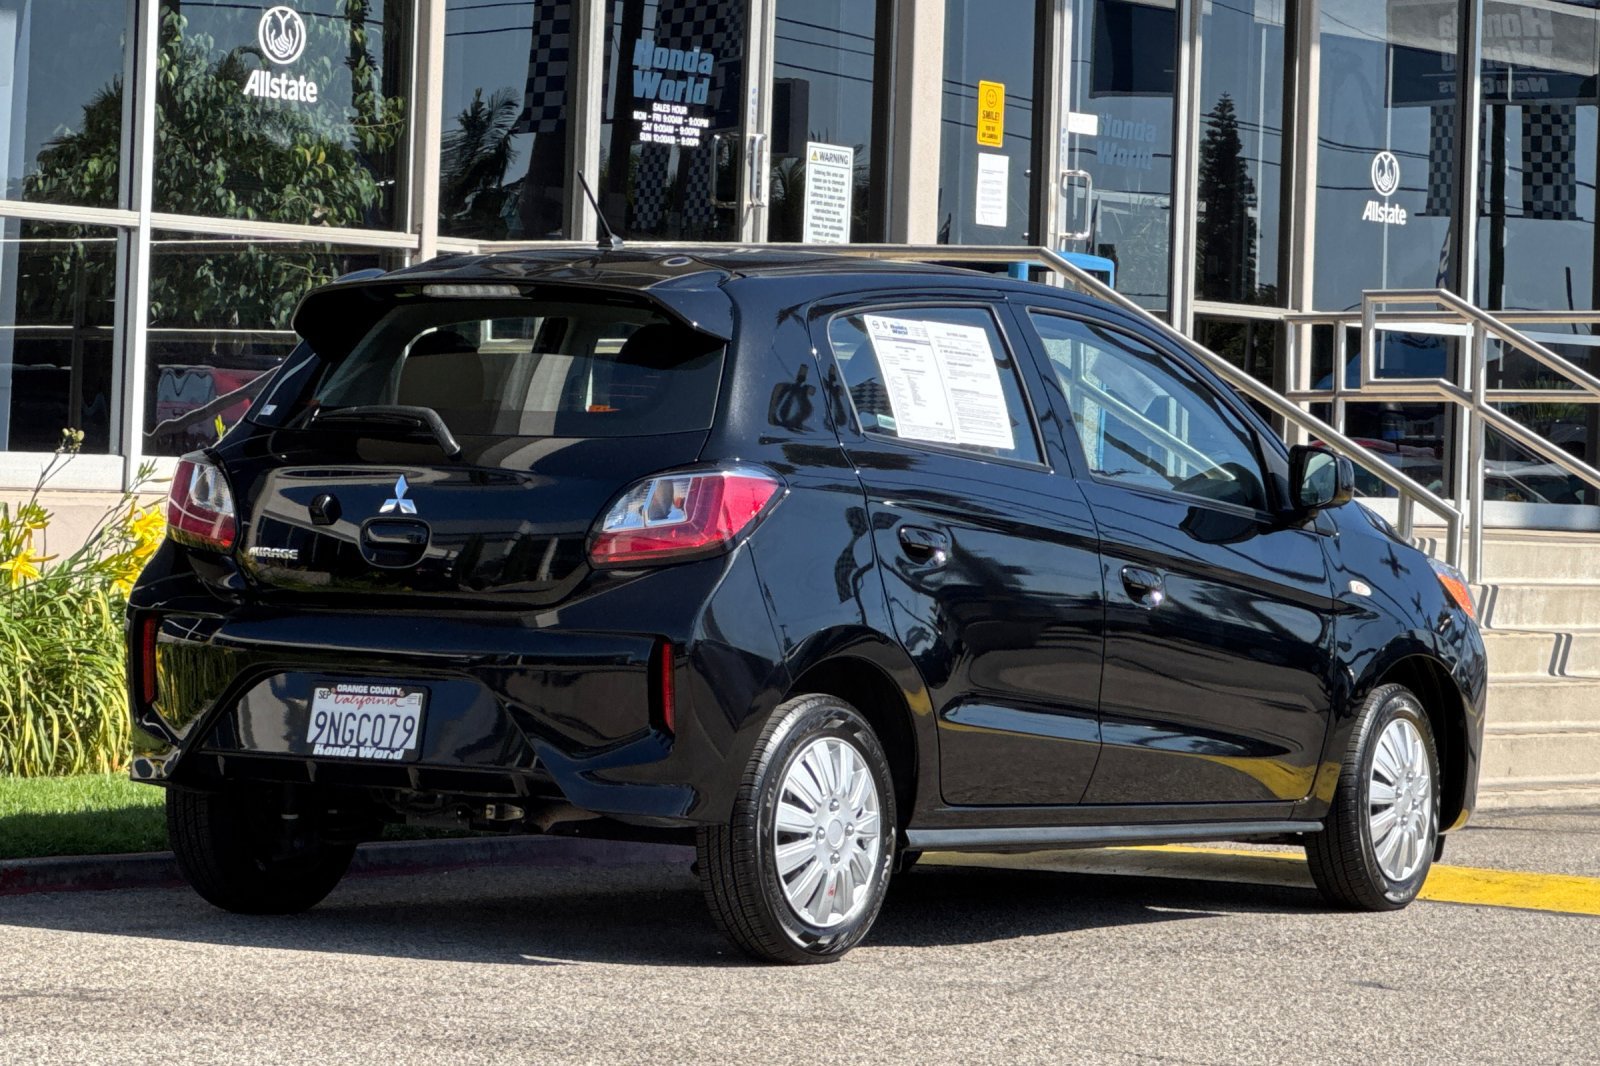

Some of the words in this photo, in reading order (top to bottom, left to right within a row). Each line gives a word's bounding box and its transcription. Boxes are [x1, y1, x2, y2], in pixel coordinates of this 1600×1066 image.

[632, 38, 714, 75] Honda
[243, 69, 318, 103] Allstate
[633, 70, 710, 105] World
[652, 102, 670, 113] SALES
[633, 110, 647, 120] MON
[819, 151, 849, 165] WARNING
[1362, 200, 1407, 225] Allstate
[249, 546, 299, 560] MIRAGE
[318, 689, 331, 699] SEP
[337, 684, 368, 694] ORANGE
[369, 686, 402, 695] COUNTY
[334, 694, 405, 710] California
[313, 710, 416, 751] 9NGC079
[312, 744, 358, 758] Honda
